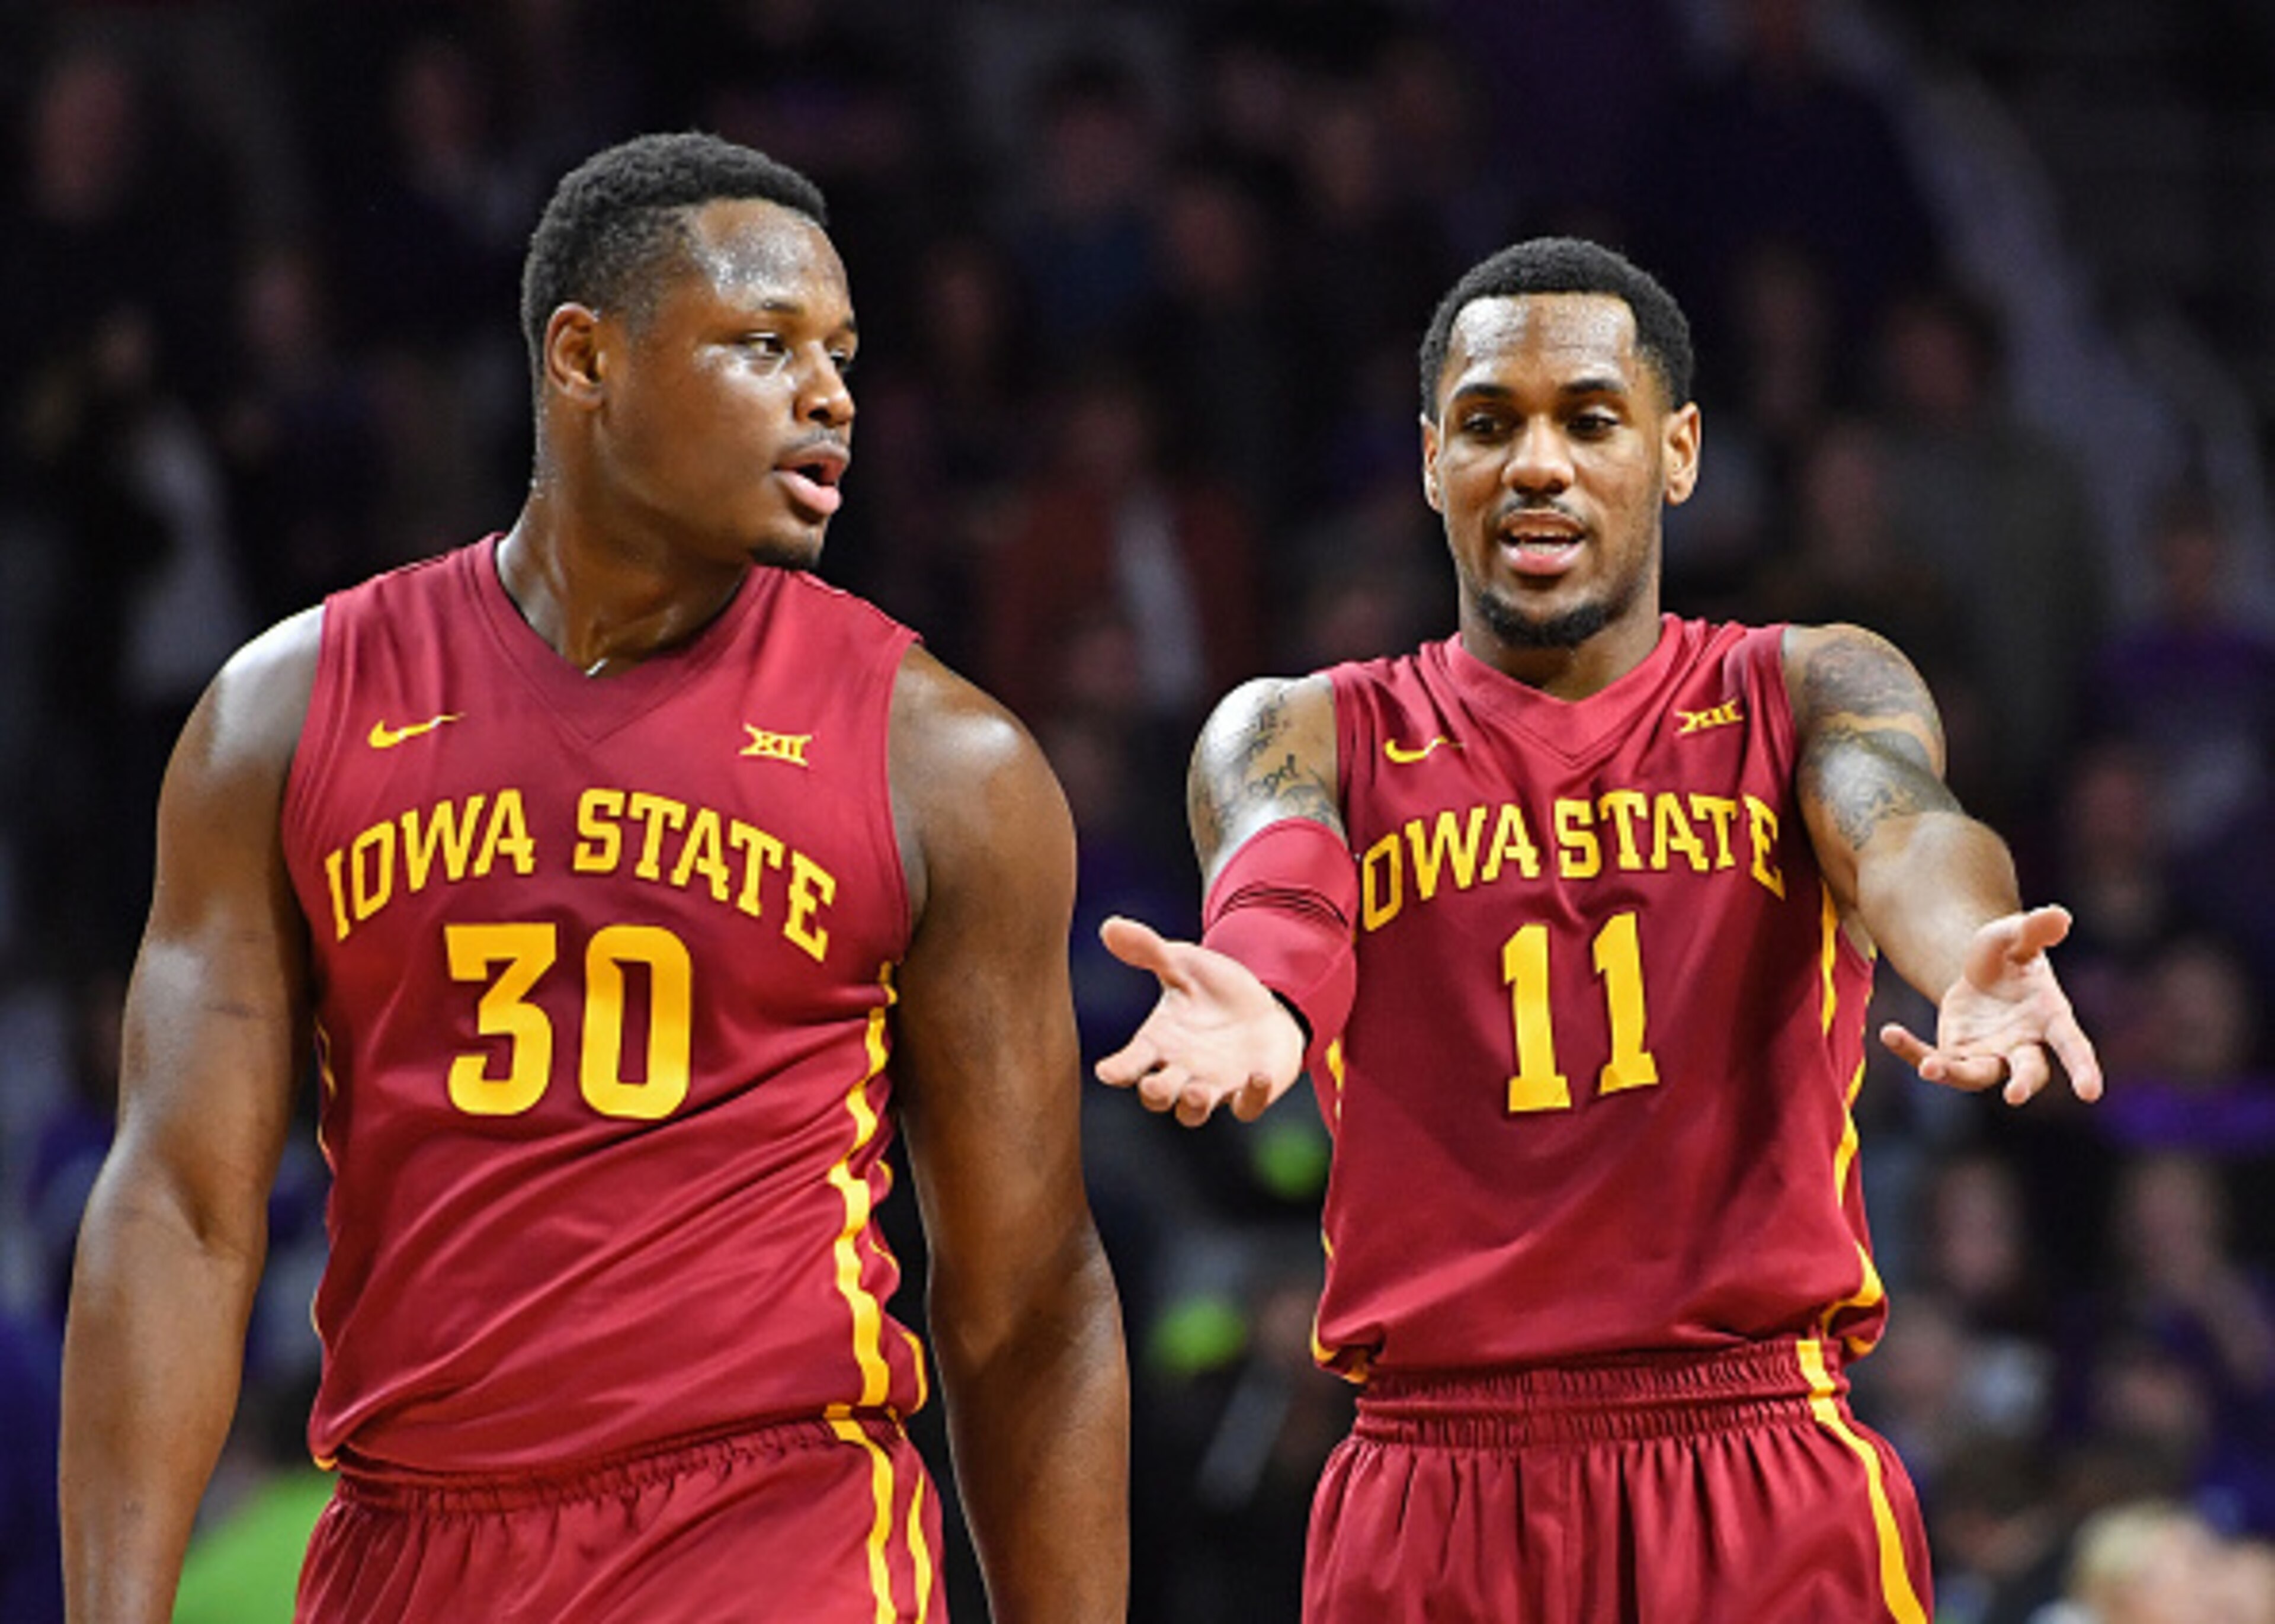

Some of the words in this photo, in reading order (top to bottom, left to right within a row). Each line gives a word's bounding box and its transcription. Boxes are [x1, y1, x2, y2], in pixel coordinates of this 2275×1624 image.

[325, 788, 536, 941] IOWA
[573, 788, 837, 962] STATE
[1352, 804, 1540, 933] OWA
[1554, 789, 1785, 900] STATE
[444, 922, 692, 1120] 30
[1501, 911, 1659, 1113] 11
